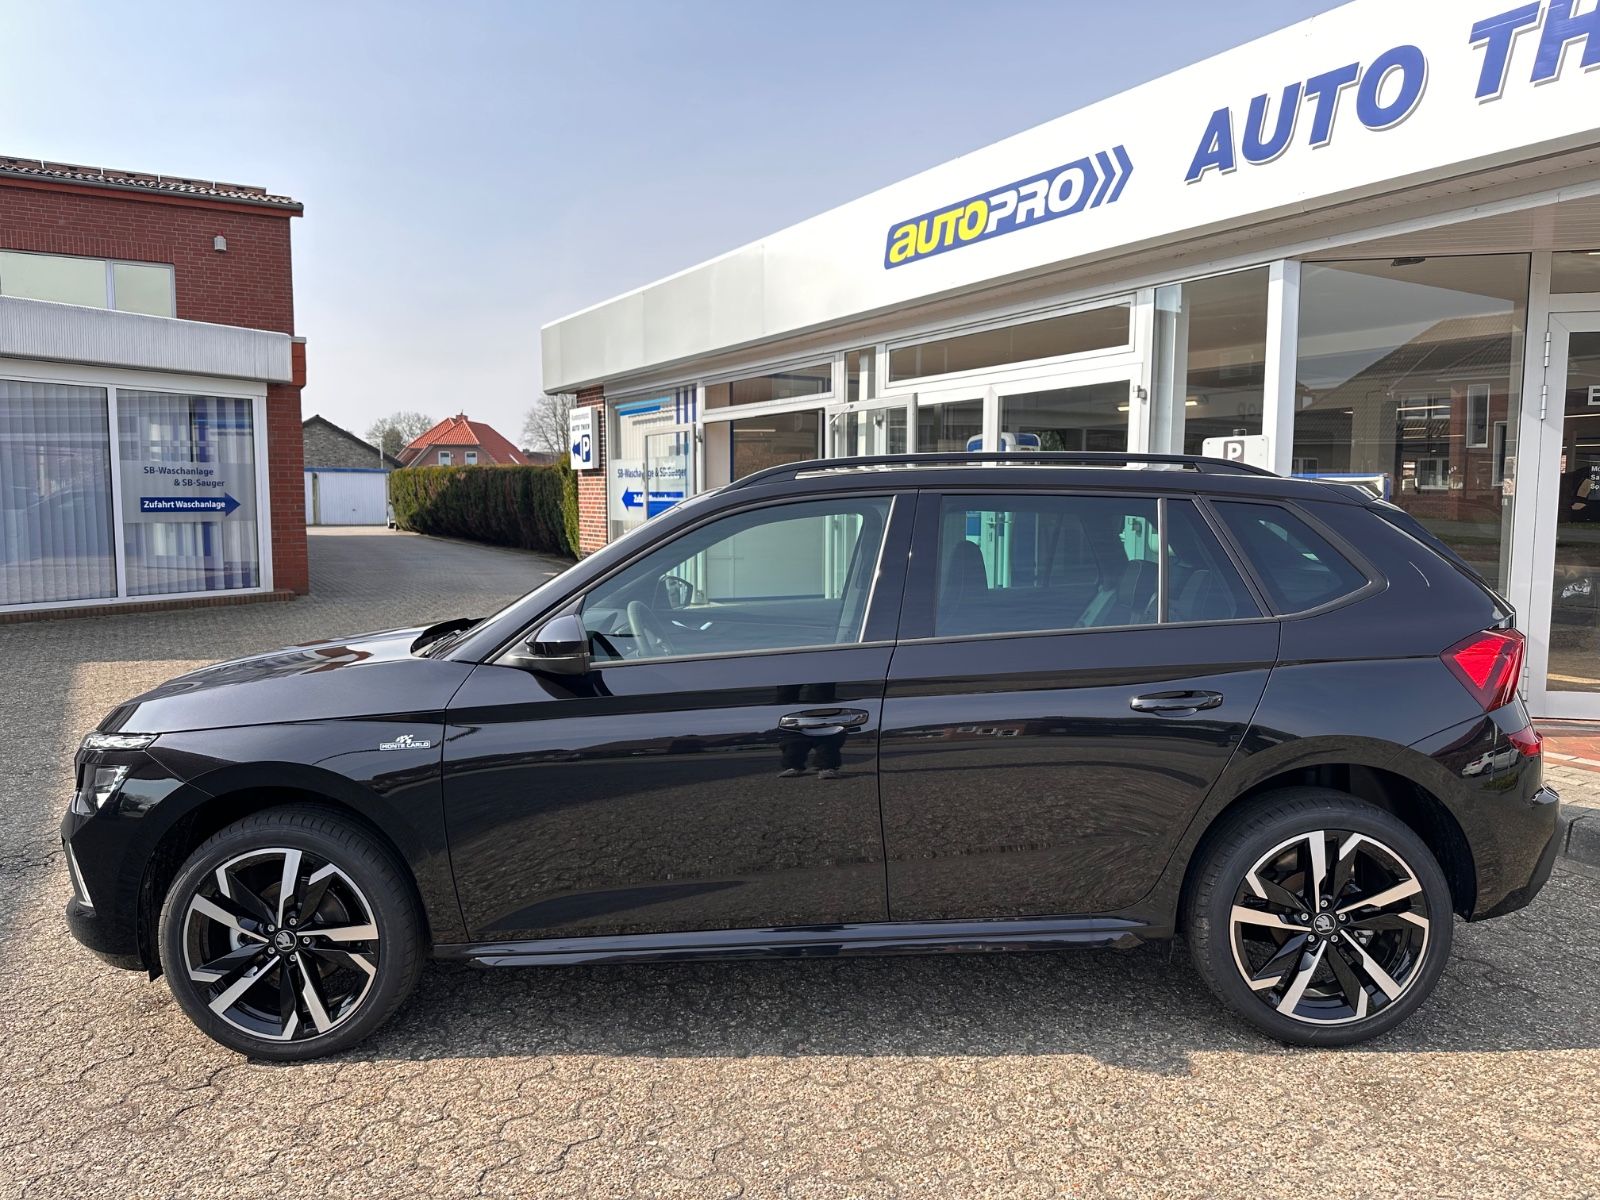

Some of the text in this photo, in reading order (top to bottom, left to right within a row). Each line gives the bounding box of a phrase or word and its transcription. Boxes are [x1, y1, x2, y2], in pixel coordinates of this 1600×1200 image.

[1184, 44, 1429, 184] AUTO
[582, 436, 590, 460] P
[1227, 442, 1242, 461] P
[143, 466, 214, 477] SB-Waschanlage
[174, 479, 225, 488] & SB-Sauger
[143, 500, 226, 510] Zufahrt Waschanlage
